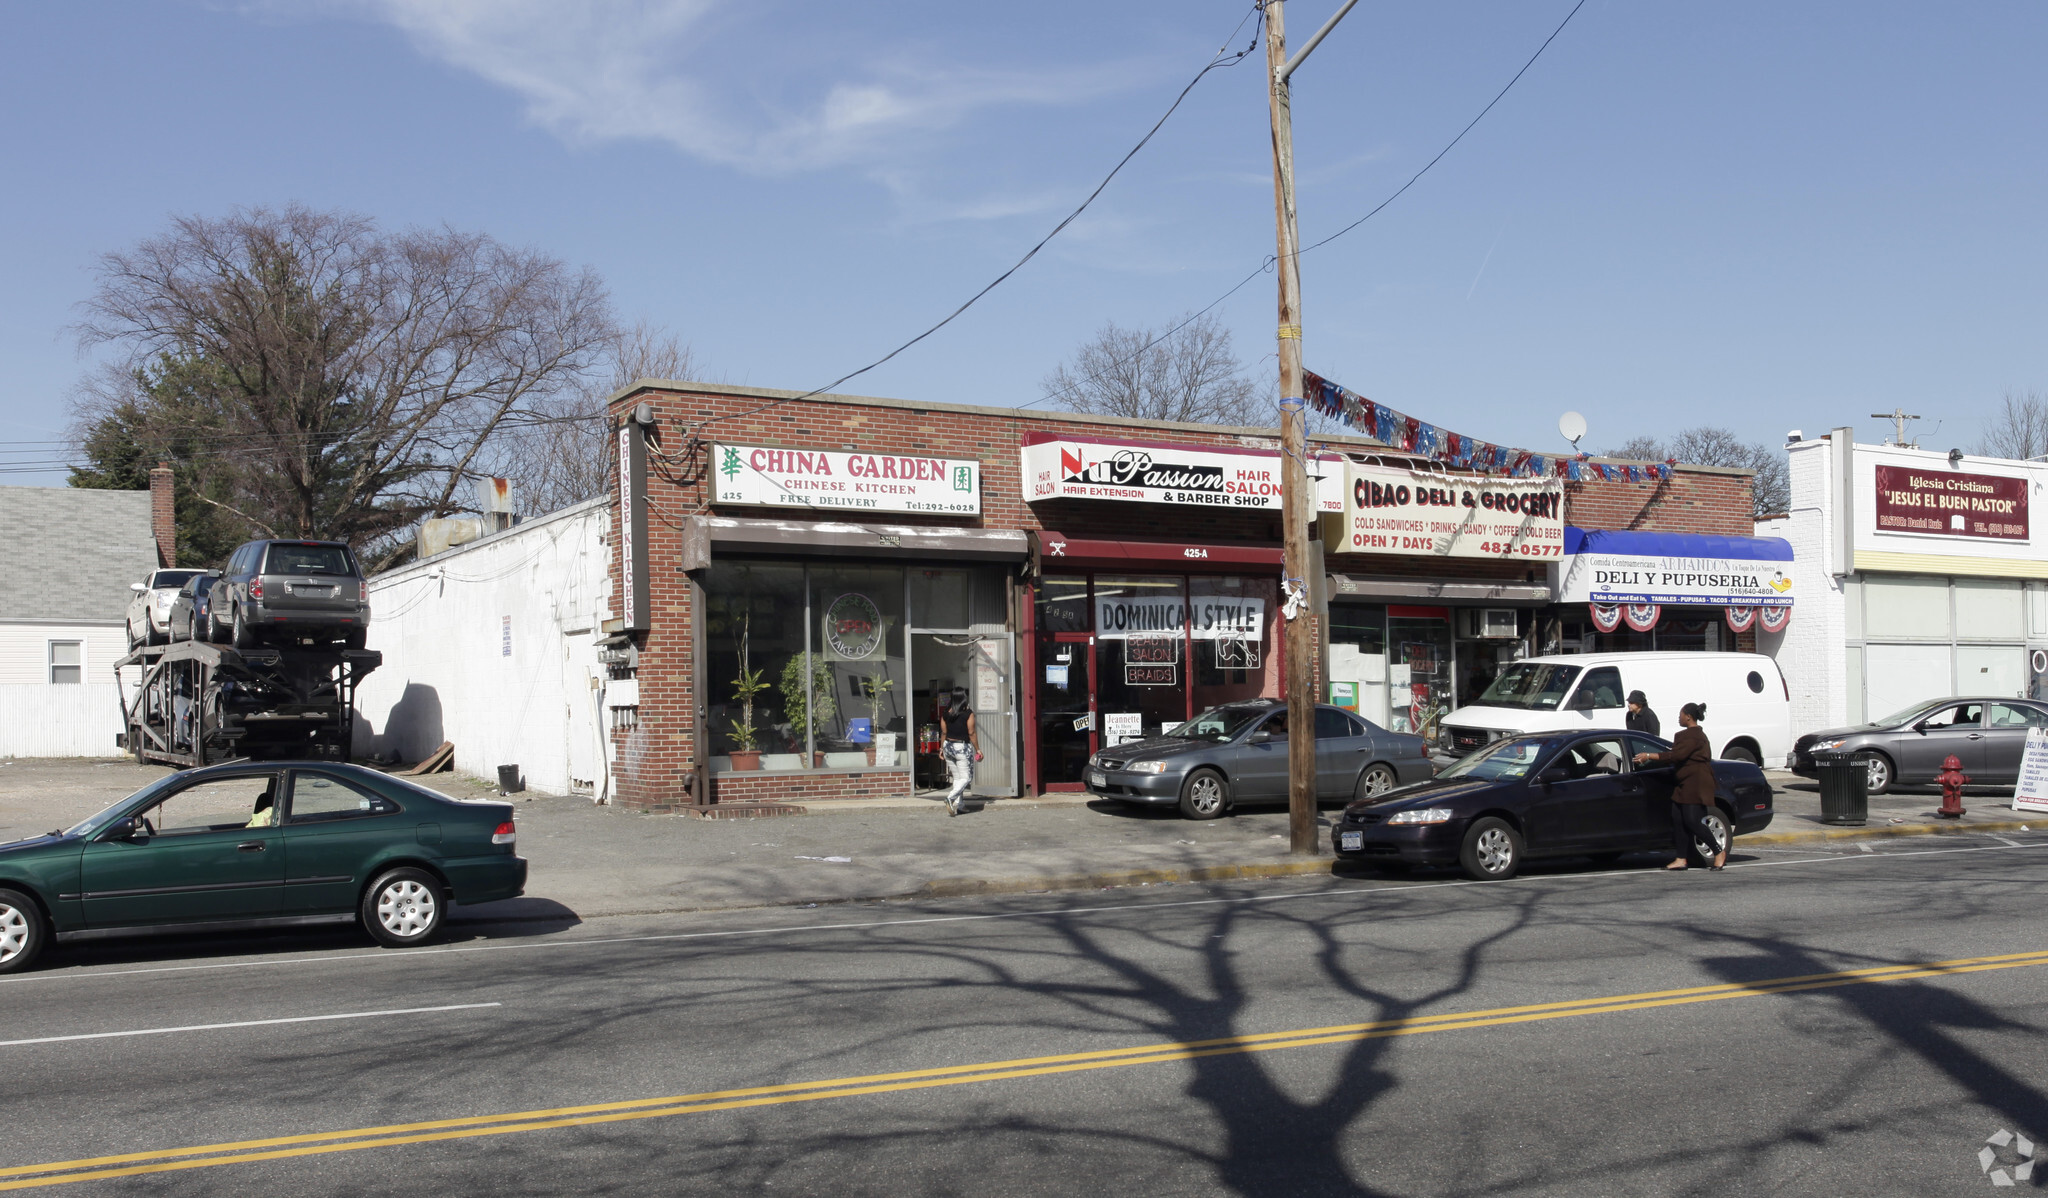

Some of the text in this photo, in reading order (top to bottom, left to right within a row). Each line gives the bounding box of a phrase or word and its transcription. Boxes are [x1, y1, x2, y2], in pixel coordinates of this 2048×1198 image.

[720, 447, 743, 482] 華
[750, 449, 946, 481] CHINA GARDEN
[1112, 450, 1224, 490] Passion
[622, 432, 632, 524] CHINESE
[953, 466, 971, 494] 園
[1038, 470, 1051, 482] HAIR
[1236, 469, 1270, 481] HAIR
[784, 479, 916, 494] CHINESE KITCHEN
[1035, 482, 1055, 496] SALON
[1063, 486, 1144, 498] HAIR EXTENSION
[1226, 481, 1282, 496] SALON
[1909, 475, 1994, 494] Iglesia Cristiana
[722, 492, 742, 500] 425
[780, 494, 878, 507] FREE DELIVERY
[1163, 491, 1269, 506] & BARBER SHOP
[1354, 478, 1561, 520] CIBAO DELI & GROCERY
[1885, 490, 2017, 513] "JESUS EL BUEN PASTOR"
[905, 501, 975, 511] Tel:292-6028
[1355, 517, 1561, 539] COLD SANDWICHES DRINKS CANDY COFFEE COLD BEER
[1880, 515, 1906, 526] PASTOR:
[1353, 533, 1433, 550] OPEN 7 DAYS
[1480, 541, 1562, 556] 483-0577
[1184, 548, 1208, 558] 425-A
[1590, 556, 1611, 567] Comida
[1660, 558, 1730, 572] ARMANDO'S
[624, 532, 634, 624] KITCHEN
[1595, 571, 1760, 587] DELI Y PUPUSERIA
[1103, 604, 1256, 632] DOMINICAN STYLE
[837, 619, 872, 633] OPEN
[831, 632, 876, 657] TAKE OUT
[1128, 634, 1172, 647] BEAUTY
[1133, 648, 1171, 661] SALON
[1129, 669, 1172, 682] BRAIDS
[1107, 715, 1140, 723] Jeannette
[2026, 741, 2036, 749] DELI
